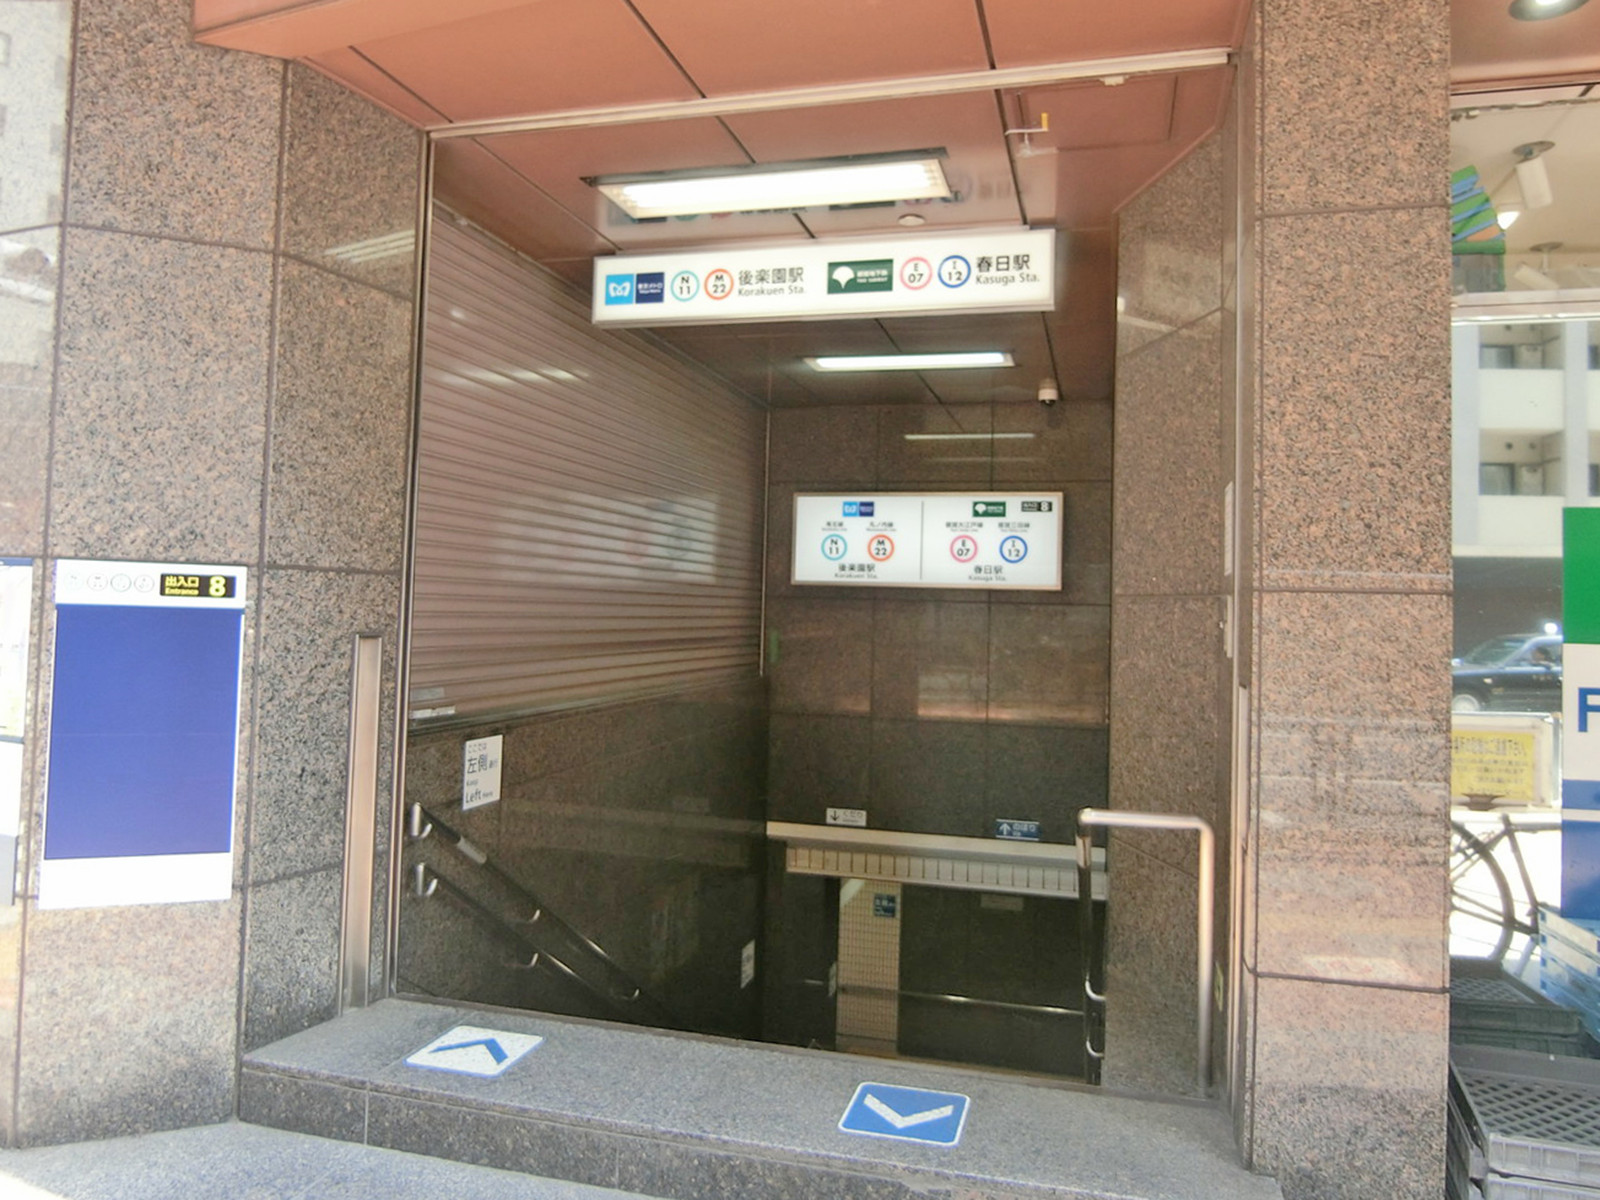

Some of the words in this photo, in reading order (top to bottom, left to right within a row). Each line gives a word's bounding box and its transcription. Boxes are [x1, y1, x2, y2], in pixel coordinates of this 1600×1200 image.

[976, 254, 1031, 273] 春日駅
[680, 276, 690, 285] N
[715, 275, 725, 283] M
[738, 267, 804, 286] 後楽園駅
[908, 273, 923, 284] 07
[947, 271, 962, 281] 12
[975, 274, 1015, 286] Kasuga
[1019, 272, 1040, 283] Sta.
[679, 286, 691, 295] 11
[712, 284, 727, 294] 22
[738, 286, 785, 297] Korakuen
[1041, 501, 1049, 511] 8
[829, 547, 840, 555] 11
[874, 548, 887, 556] 22
[957, 548, 970, 557] 07
[1008, 549, 1020, 558] 12
[973, 565, 1004, 575] 春日駅
[164, 575, 200, 588] 出入口
[208, 575, 227, 597] 8
[164, 587, 200, 596] Entrance
